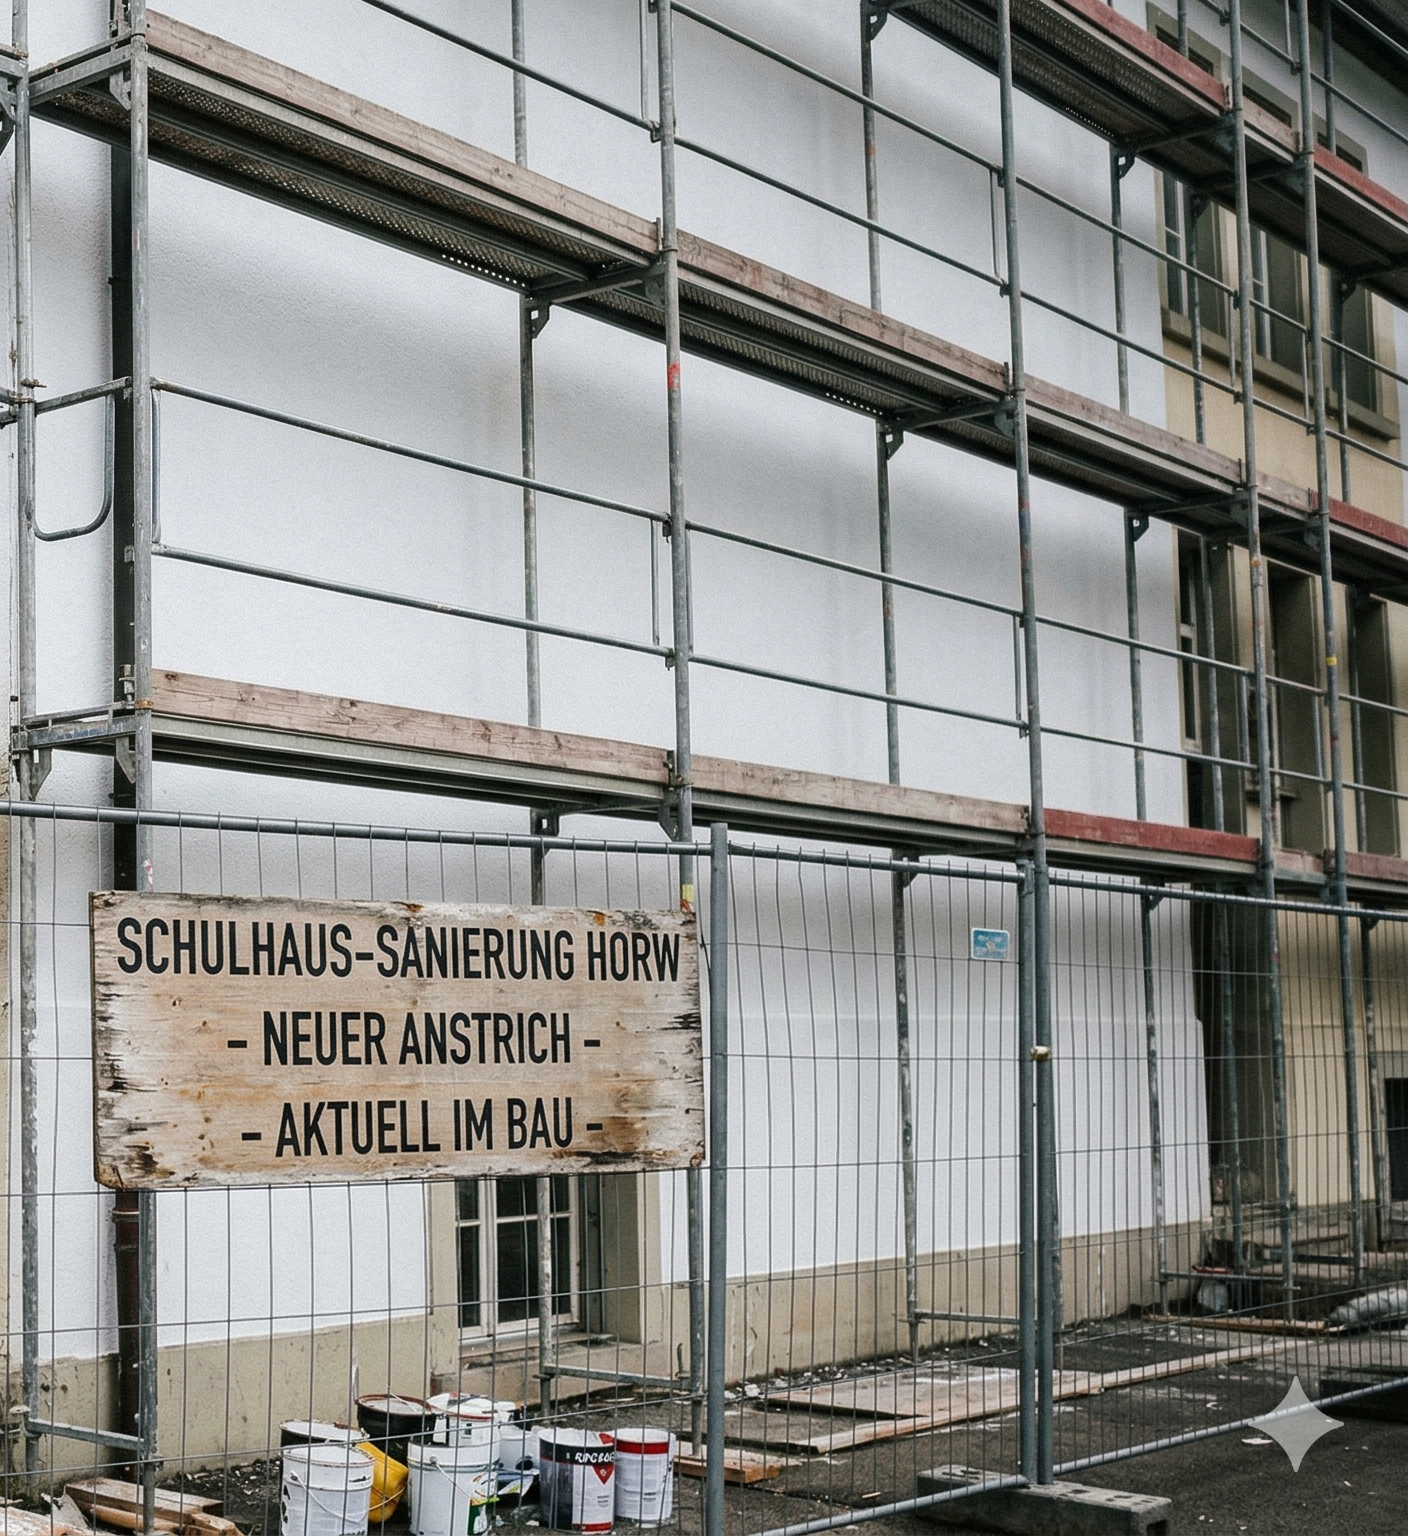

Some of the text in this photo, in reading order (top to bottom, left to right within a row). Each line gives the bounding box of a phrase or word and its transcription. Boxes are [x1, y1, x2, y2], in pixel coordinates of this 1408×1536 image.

[117, 917, 680, 982] SCHULHAUS-SANIERUNG HORW
[263, 1011, 388, 1066] NEUER
[398, 1012, 571, 1065] ANSTRICH
[275, 1100, 441, 1158] AKTUELL
[453, 1098, 493, 1152] IM
[507, 1096, 573, 1151] BAU
